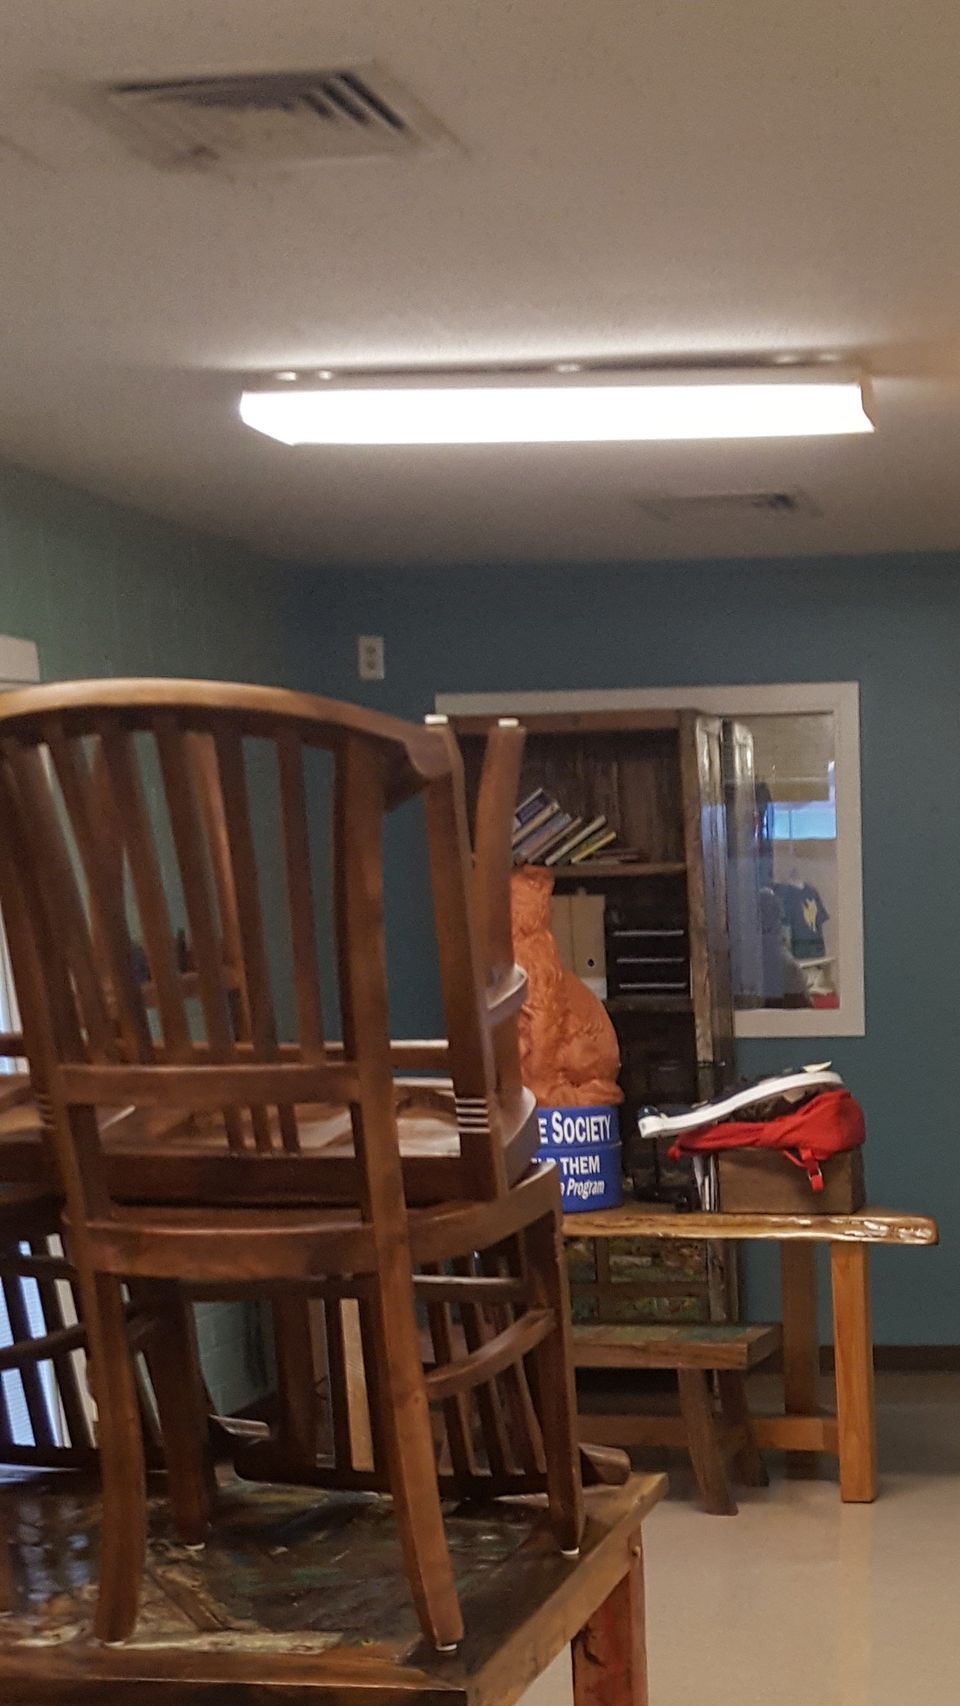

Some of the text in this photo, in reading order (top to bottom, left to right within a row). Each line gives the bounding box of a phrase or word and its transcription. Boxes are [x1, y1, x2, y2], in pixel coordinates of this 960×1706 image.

[552, 1110, 611, 1144] SOCIETY
[559, 1155, 601, 1175] THEM
[566, 1177, 605, 1200] Program
